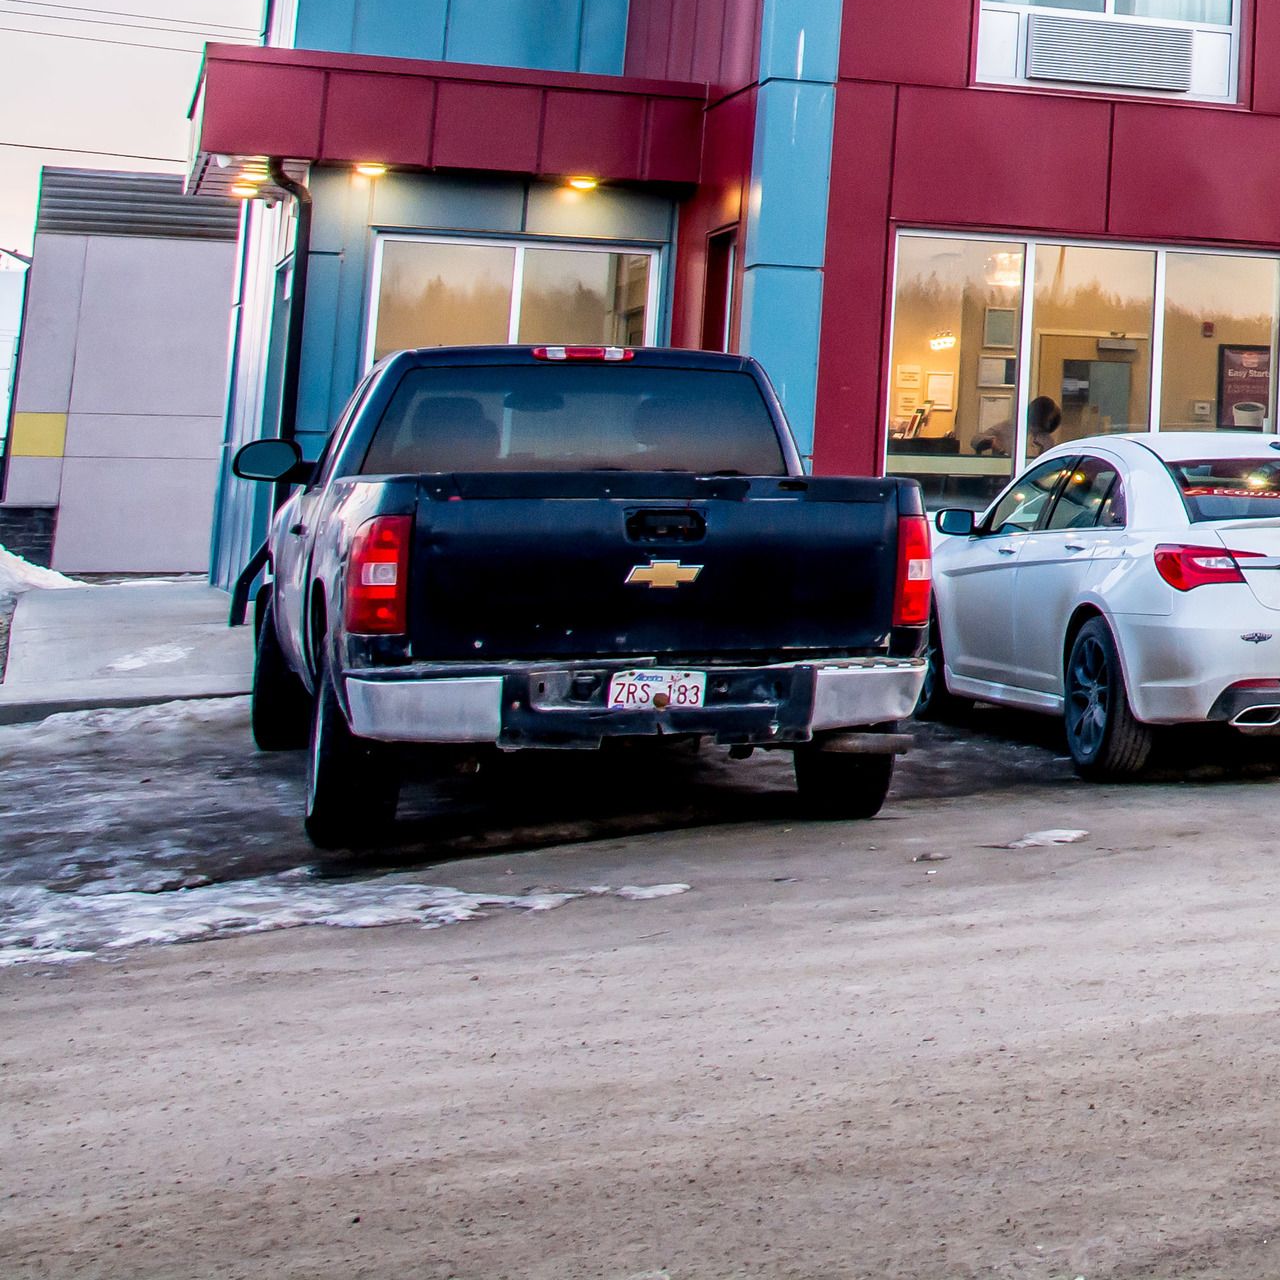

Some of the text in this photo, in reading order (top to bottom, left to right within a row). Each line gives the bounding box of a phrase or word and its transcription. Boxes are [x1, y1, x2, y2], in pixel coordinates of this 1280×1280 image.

[1228, 368, 1247, 378] Easy
[613, 682, 700, 705] ZRS 183
